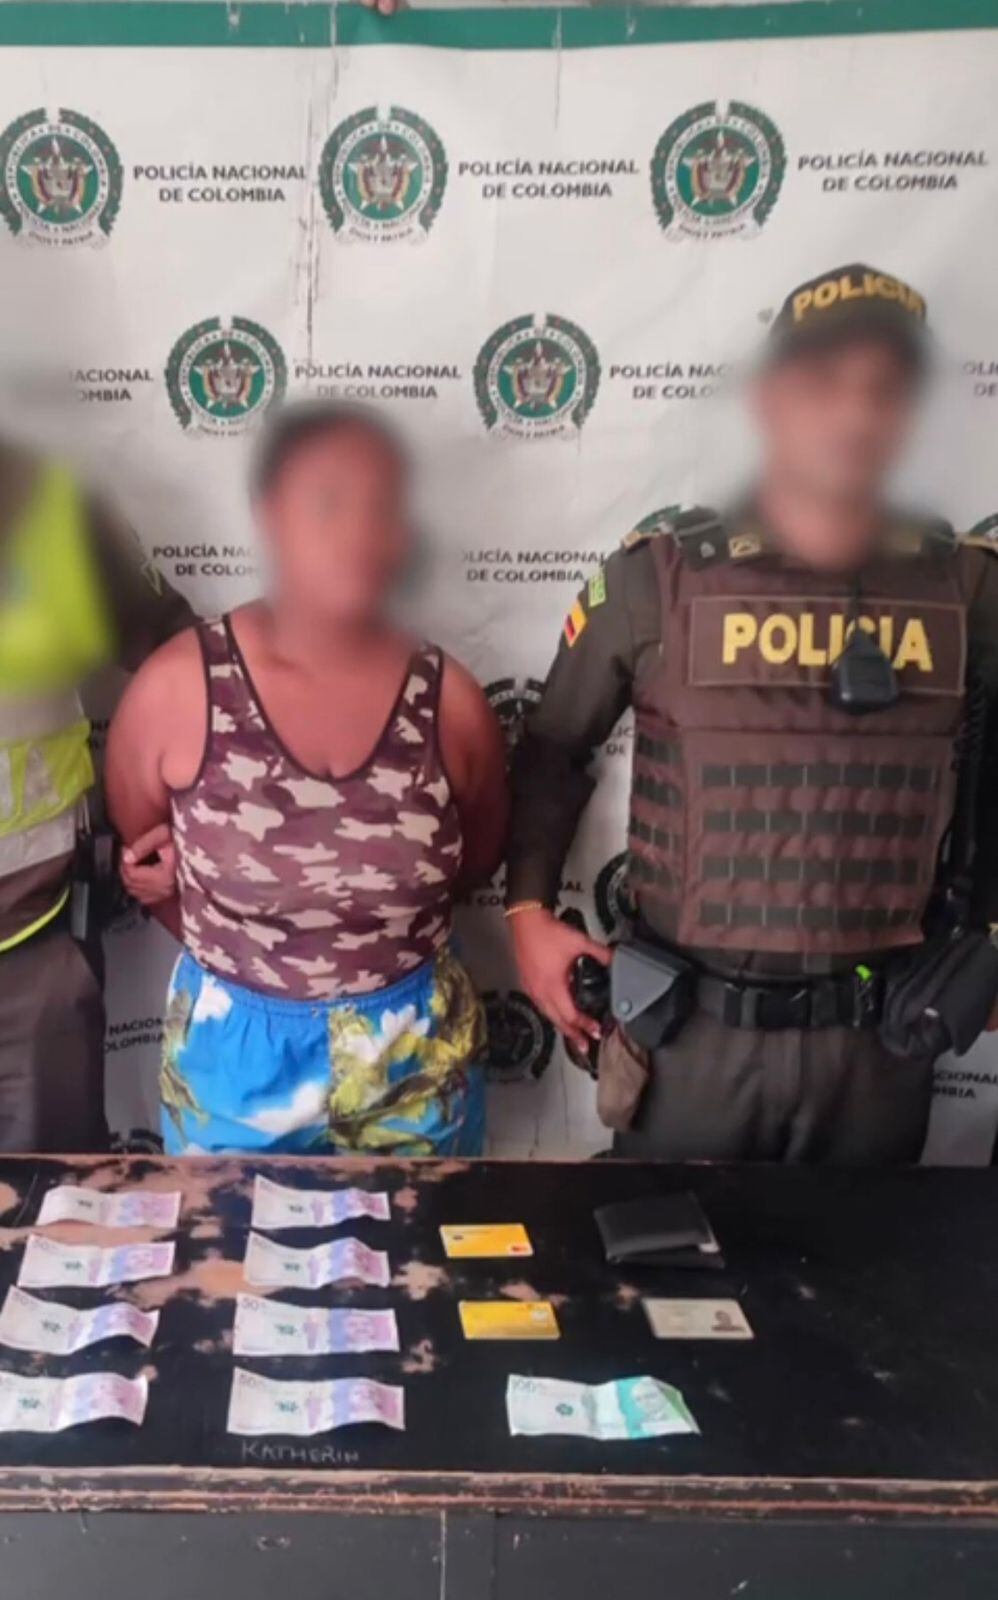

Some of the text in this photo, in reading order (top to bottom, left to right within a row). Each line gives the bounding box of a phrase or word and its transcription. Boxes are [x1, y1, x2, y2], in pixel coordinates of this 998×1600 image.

[458, 157, 640, 176] POLICÍA NACIONAL
[798, 150, 988, 170] POLICÍA NACIONAL
[133, 161, 306, 181] POLICÍA NACIONAL
[482, 182, 612, 198] DE COLOMBIA
[822, 174, 958, 192] DE COLOMBIA
[159, 188, 286, 202] DE COLOMBIA
[294, 361, 462, 379] POLICÍA NACIONAL
[610, 361, 683, 379] POLICÍA
[317, 385, 439, 399] DE COLOMBIA
[633, 385, 656, 399] DE
[152, 543, 219, 558] POLICÍA
[174, 563, 197, 576] DE
[466, 568, 584, 582] DE COLOMBIA
